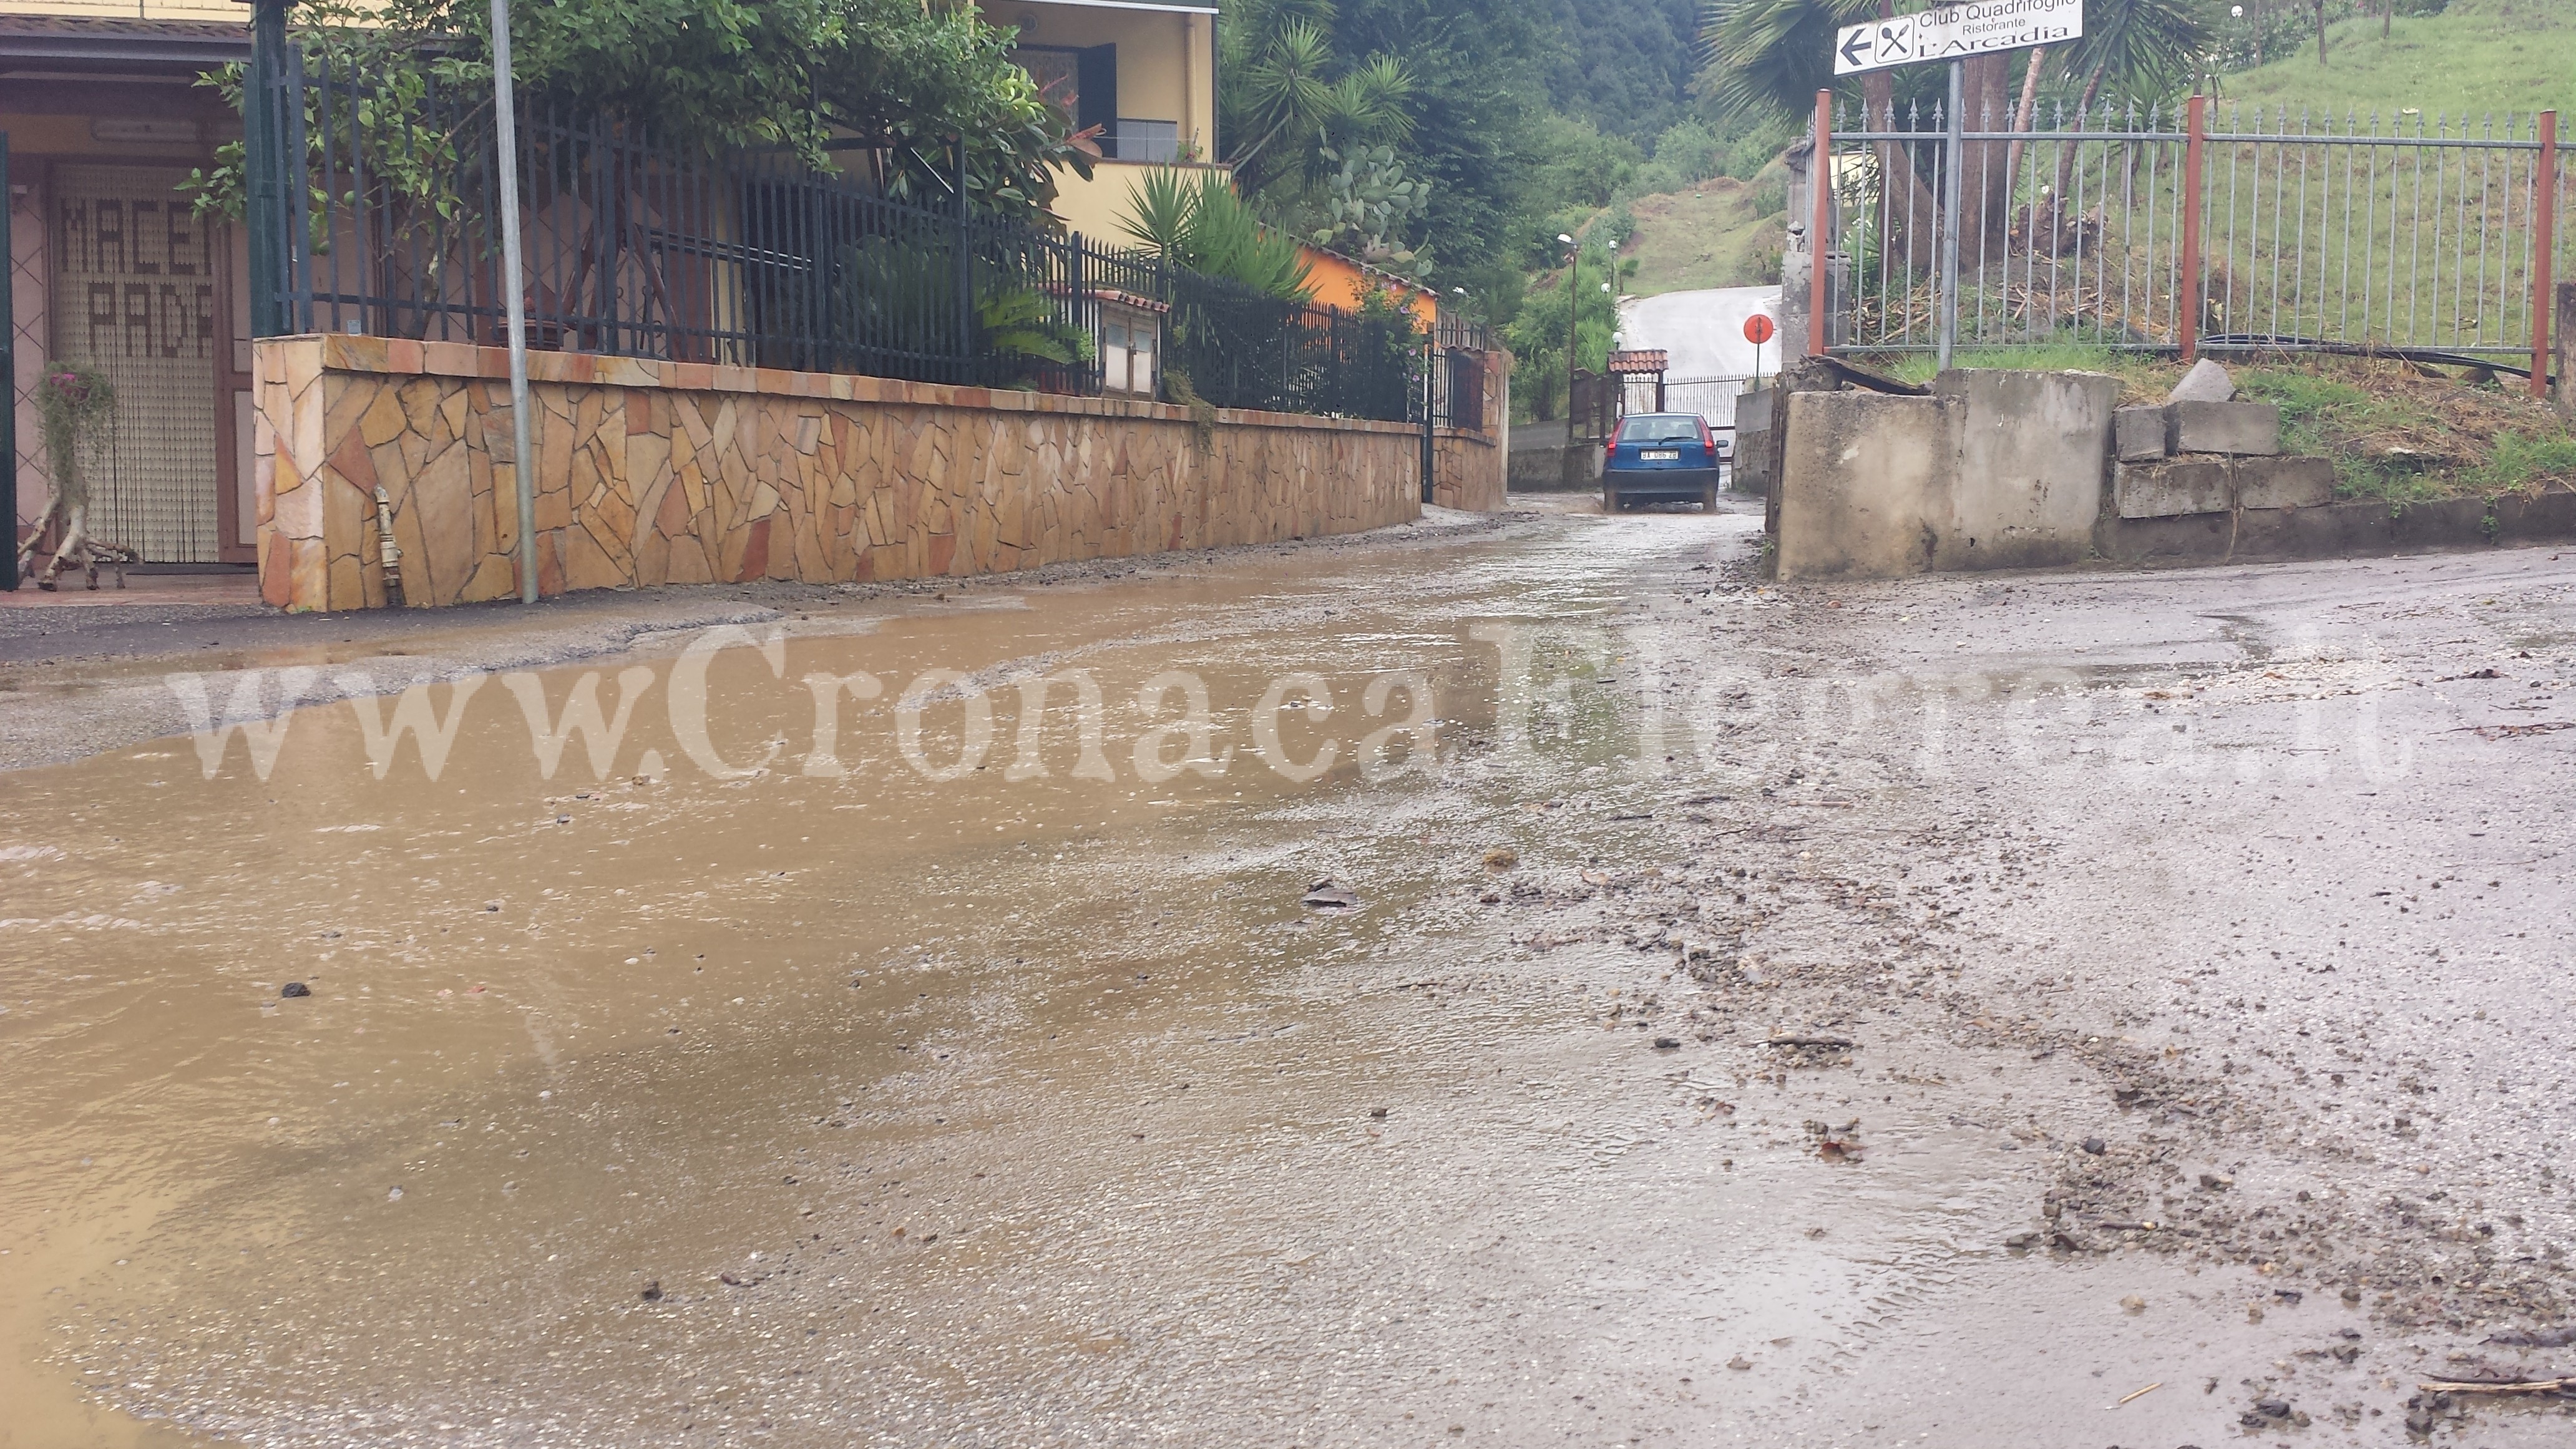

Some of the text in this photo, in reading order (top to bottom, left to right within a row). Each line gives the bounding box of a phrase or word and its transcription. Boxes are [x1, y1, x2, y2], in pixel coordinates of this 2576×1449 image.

[1920, 11, 1959, 27] Club
[1963, 18, 2026, 36] Ristorante
[1920, 26, 2068, 57] L'Arcadia
